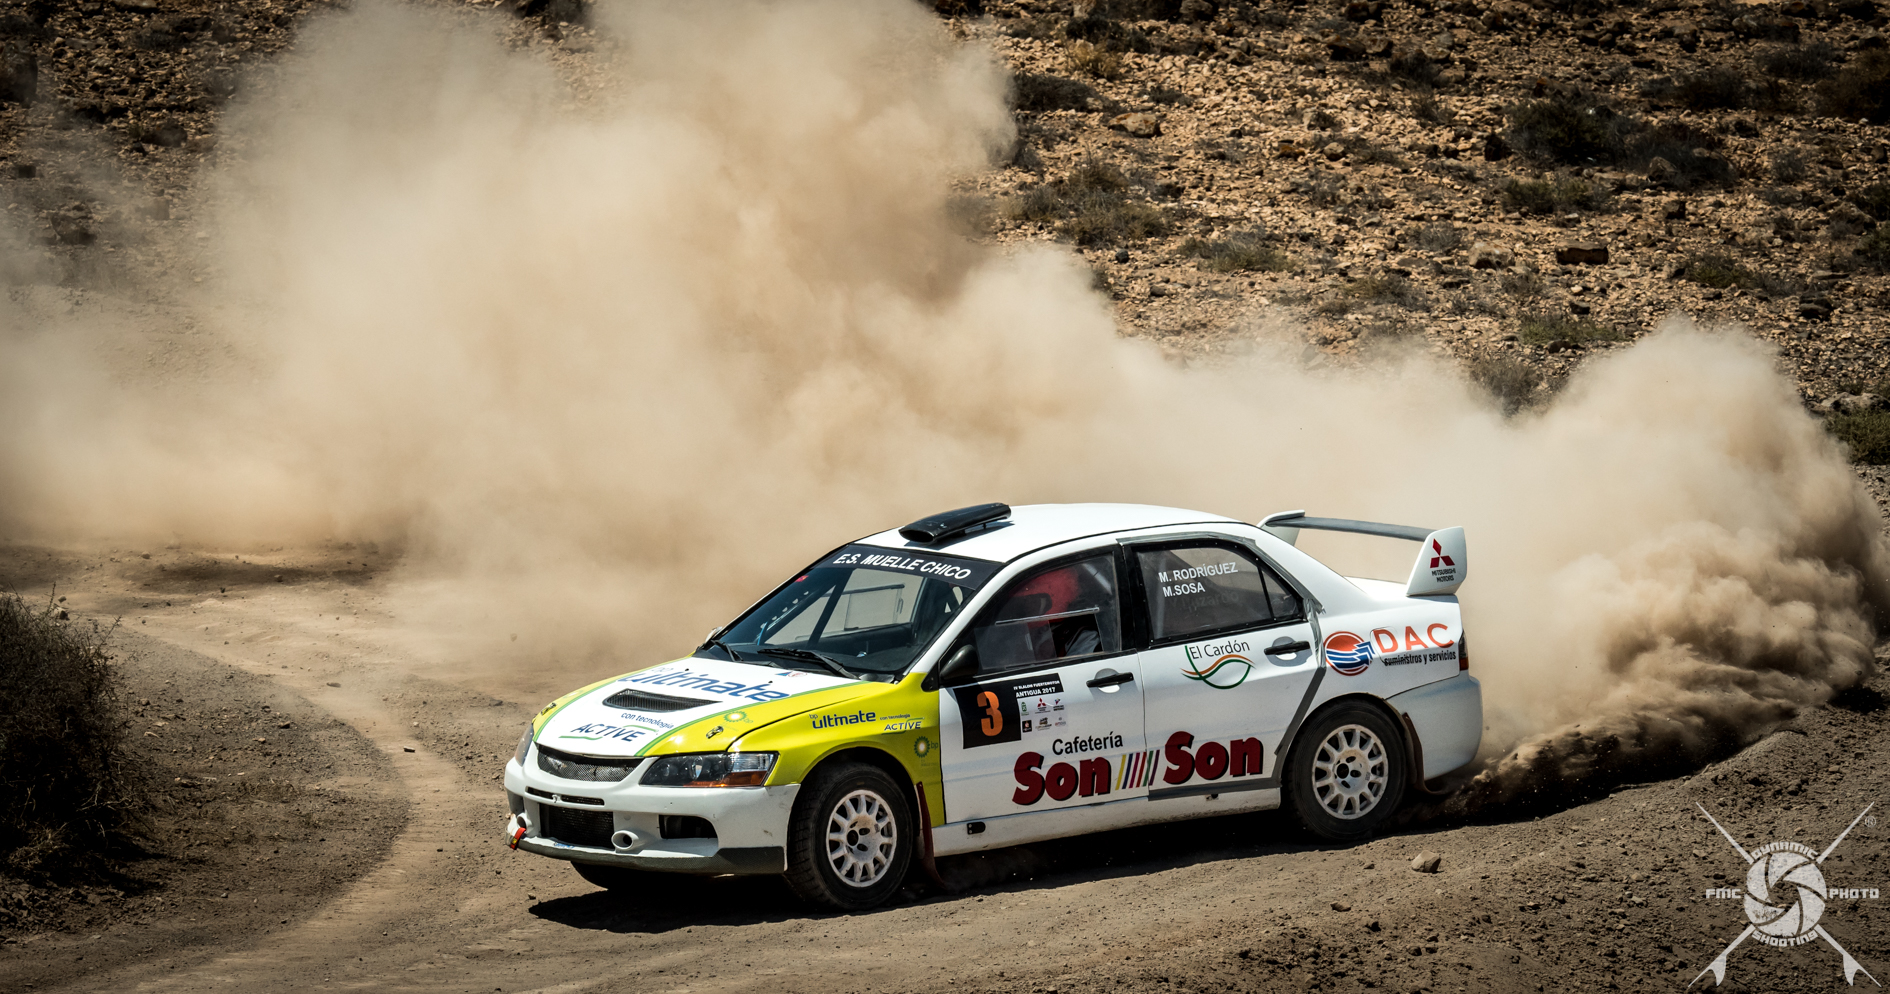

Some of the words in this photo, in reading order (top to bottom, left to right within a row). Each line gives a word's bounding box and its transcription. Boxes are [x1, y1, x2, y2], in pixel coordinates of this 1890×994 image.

[833, 553, 861, 564] E.S.
[861, 554, 924, 570] MUELLE
[920, 561, 971, 579] CHICO
[1158, 571, 1172, 583] M.
[1173, 562, 1238, 581] RODRÍGUEZ
[1162, 582, 1205, 597] M.SOSA
[1372, 622, 1455, 653] DAC
[1189, 645, 1202, 659] El
[1204, 640, 1251, 657] Cardón
[1384, 653, 1422, 666] suministros
[1424, 655, 1428, 665] y
[1429, 650, 1457, 662] servicios
[618, 671, 790, 702] ultimate
[1016, 689, 1042, 698] ANTIGUA
[1042, 686, 1056, 694] 2017
[621, 712, 636, 720] con
[812, 710, 876, 729] ultimate
[976, 691, 1003, 737] 3
[570, 723, 646, 742] ACTIVE
[884, 721, 922, 731] ACTIVE
[931, 741, 939, 750] bp
[1052, 731, 1123, 755] Cafetería
[1011, 751, 1112, 806] Son
[1163, 730, 1264, 785] Son
